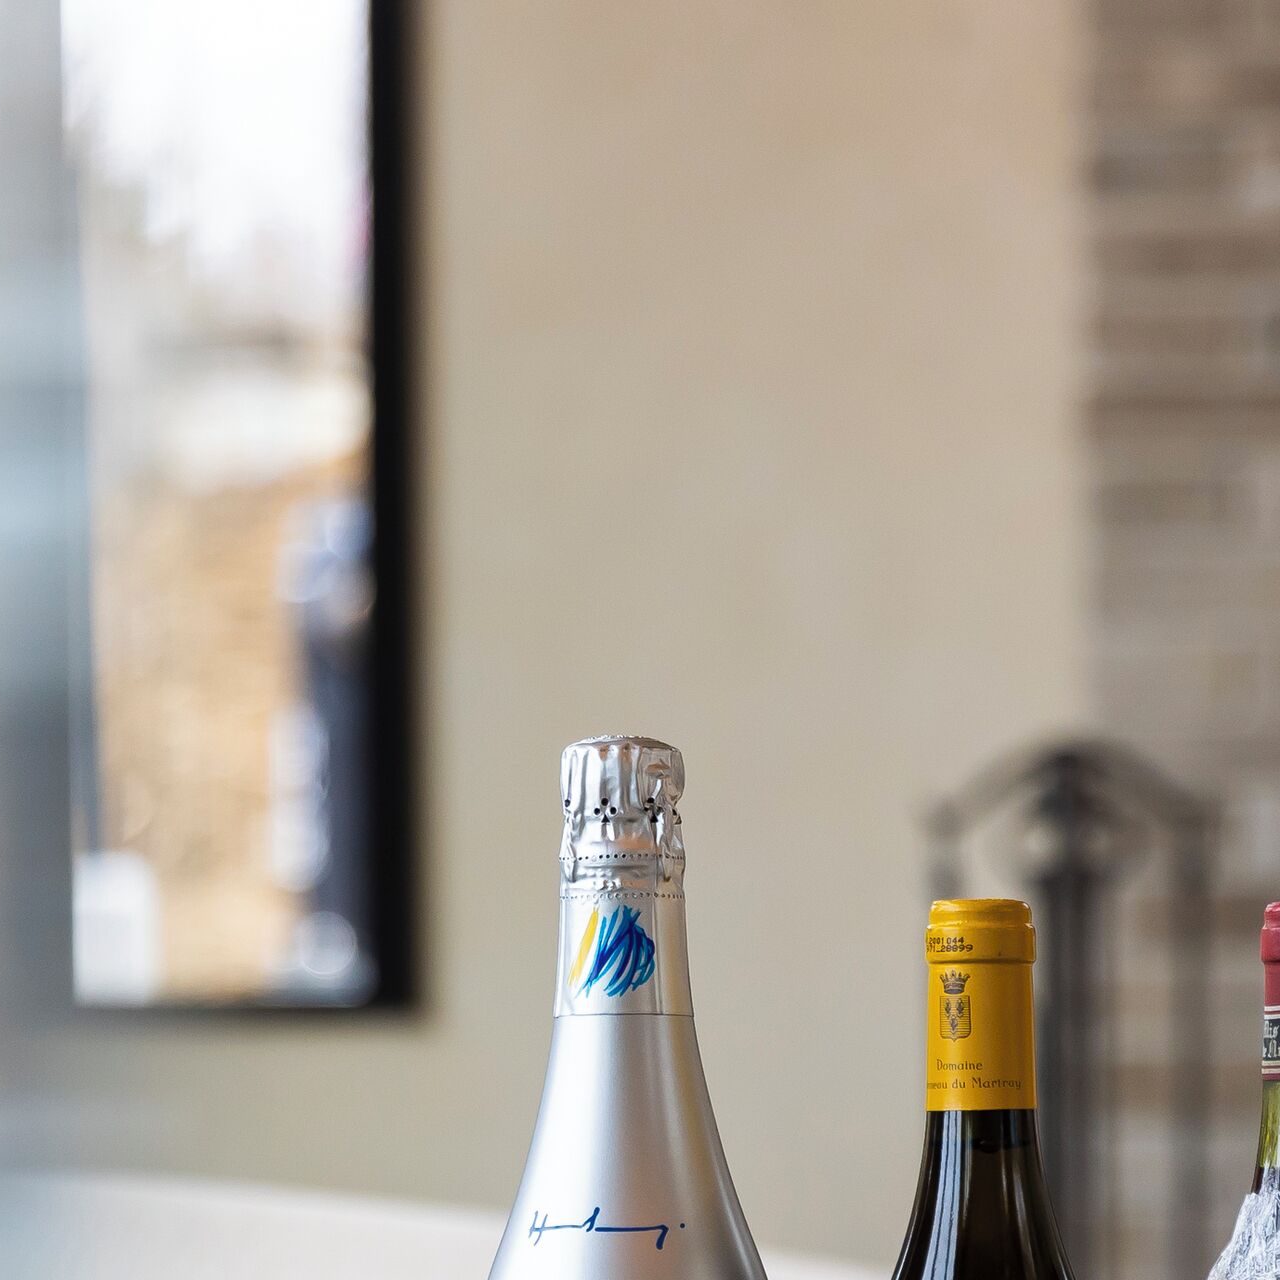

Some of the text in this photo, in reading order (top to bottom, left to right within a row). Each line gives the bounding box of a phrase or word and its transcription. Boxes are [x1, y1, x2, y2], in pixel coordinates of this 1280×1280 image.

[936, 1058, 983, 1071] Domaine
[952, 1079, 966, 1089] du
[972, 1076, 1022, 1090] Martray
